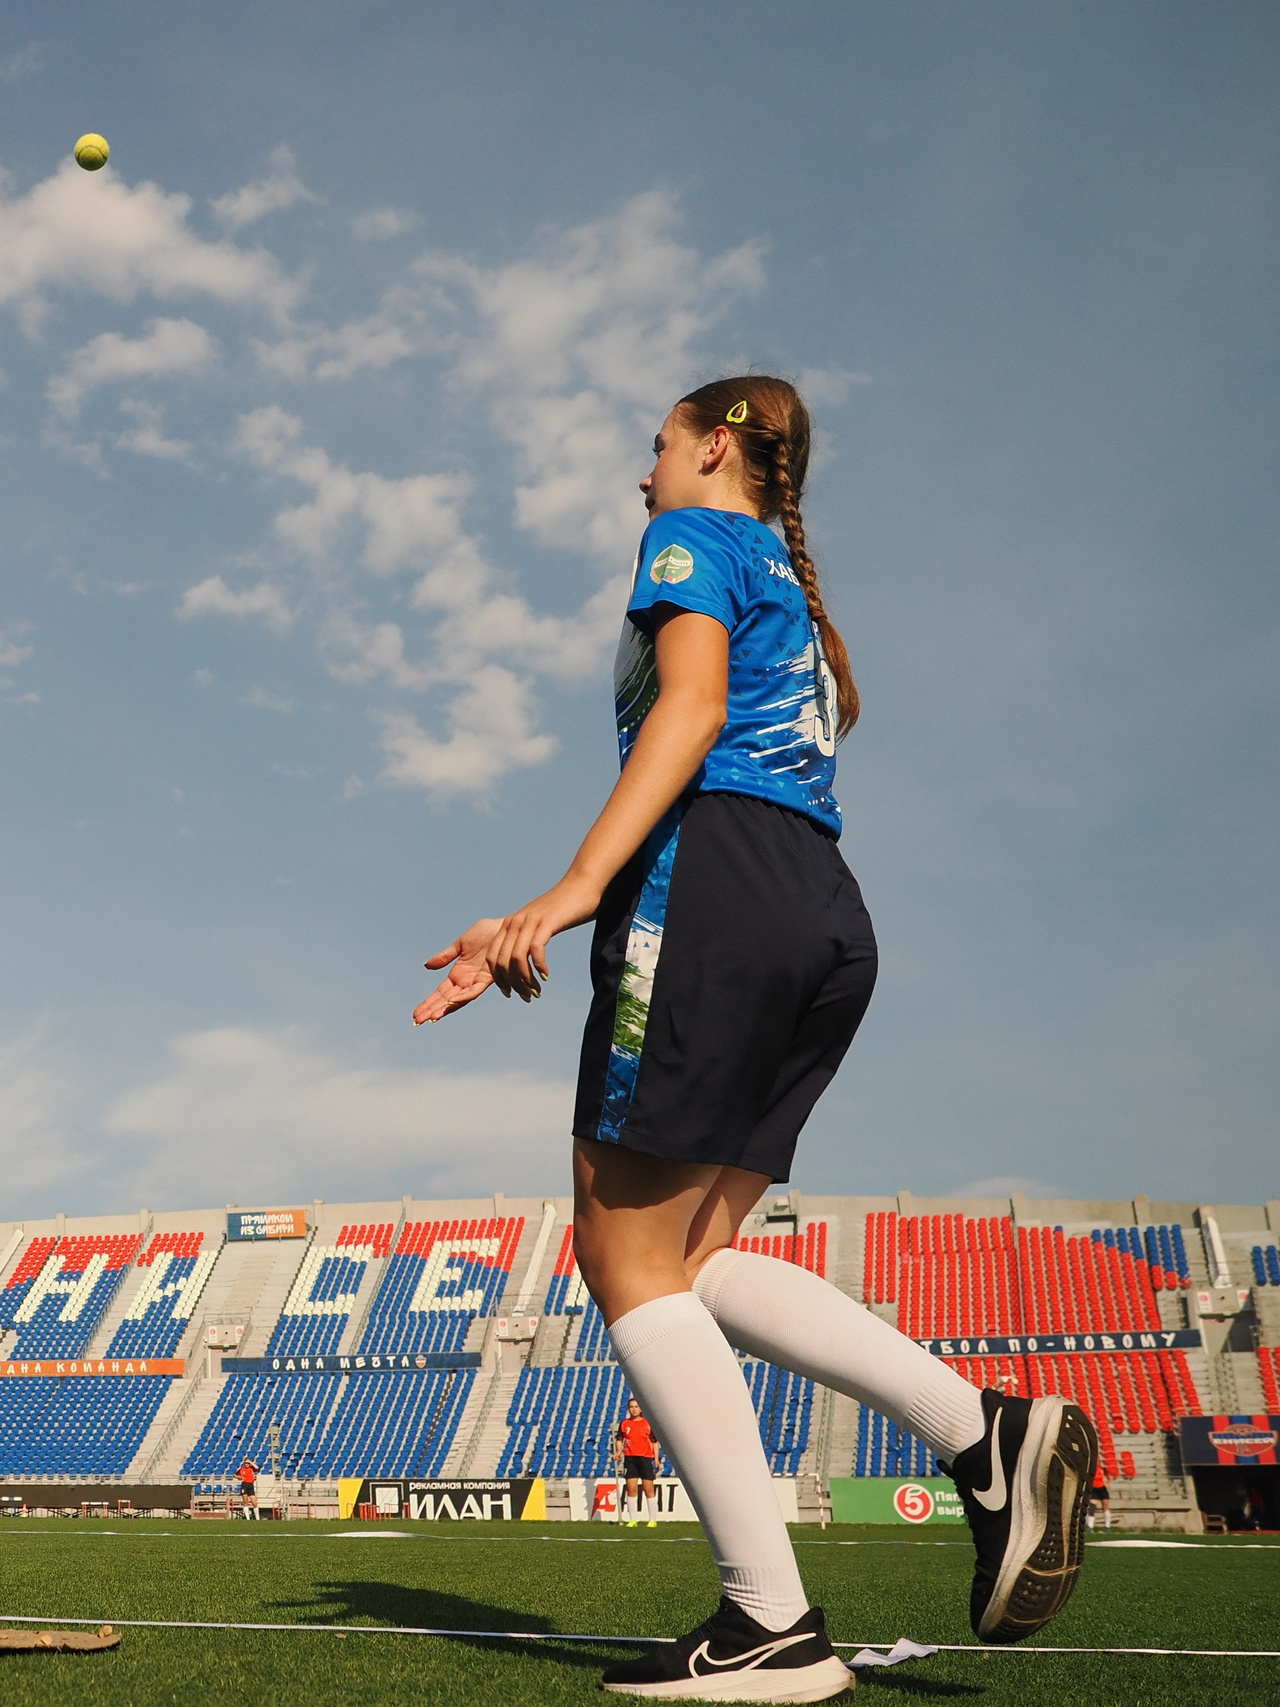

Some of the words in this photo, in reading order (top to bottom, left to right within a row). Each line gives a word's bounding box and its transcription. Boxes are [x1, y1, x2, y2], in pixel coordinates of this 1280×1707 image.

[240, 1213, 294, 1225] ПРЯМИКОМ
[240, 1226, 255, 1236] ИЗ
[255, 1224, 294, 1235] СИБИРИ
[1008, 1332, 1176, 1353] ПО-НОВОМУ
[56, 1360, 148, 1374] КОМАНДА
[272, 1358, 324, 1371] ОДНА
[409, 1481, 462, 1490] рекламная
[463, 1481, 510, 1490] компания
[408, 1494, 512, 1520] ИЛАН
